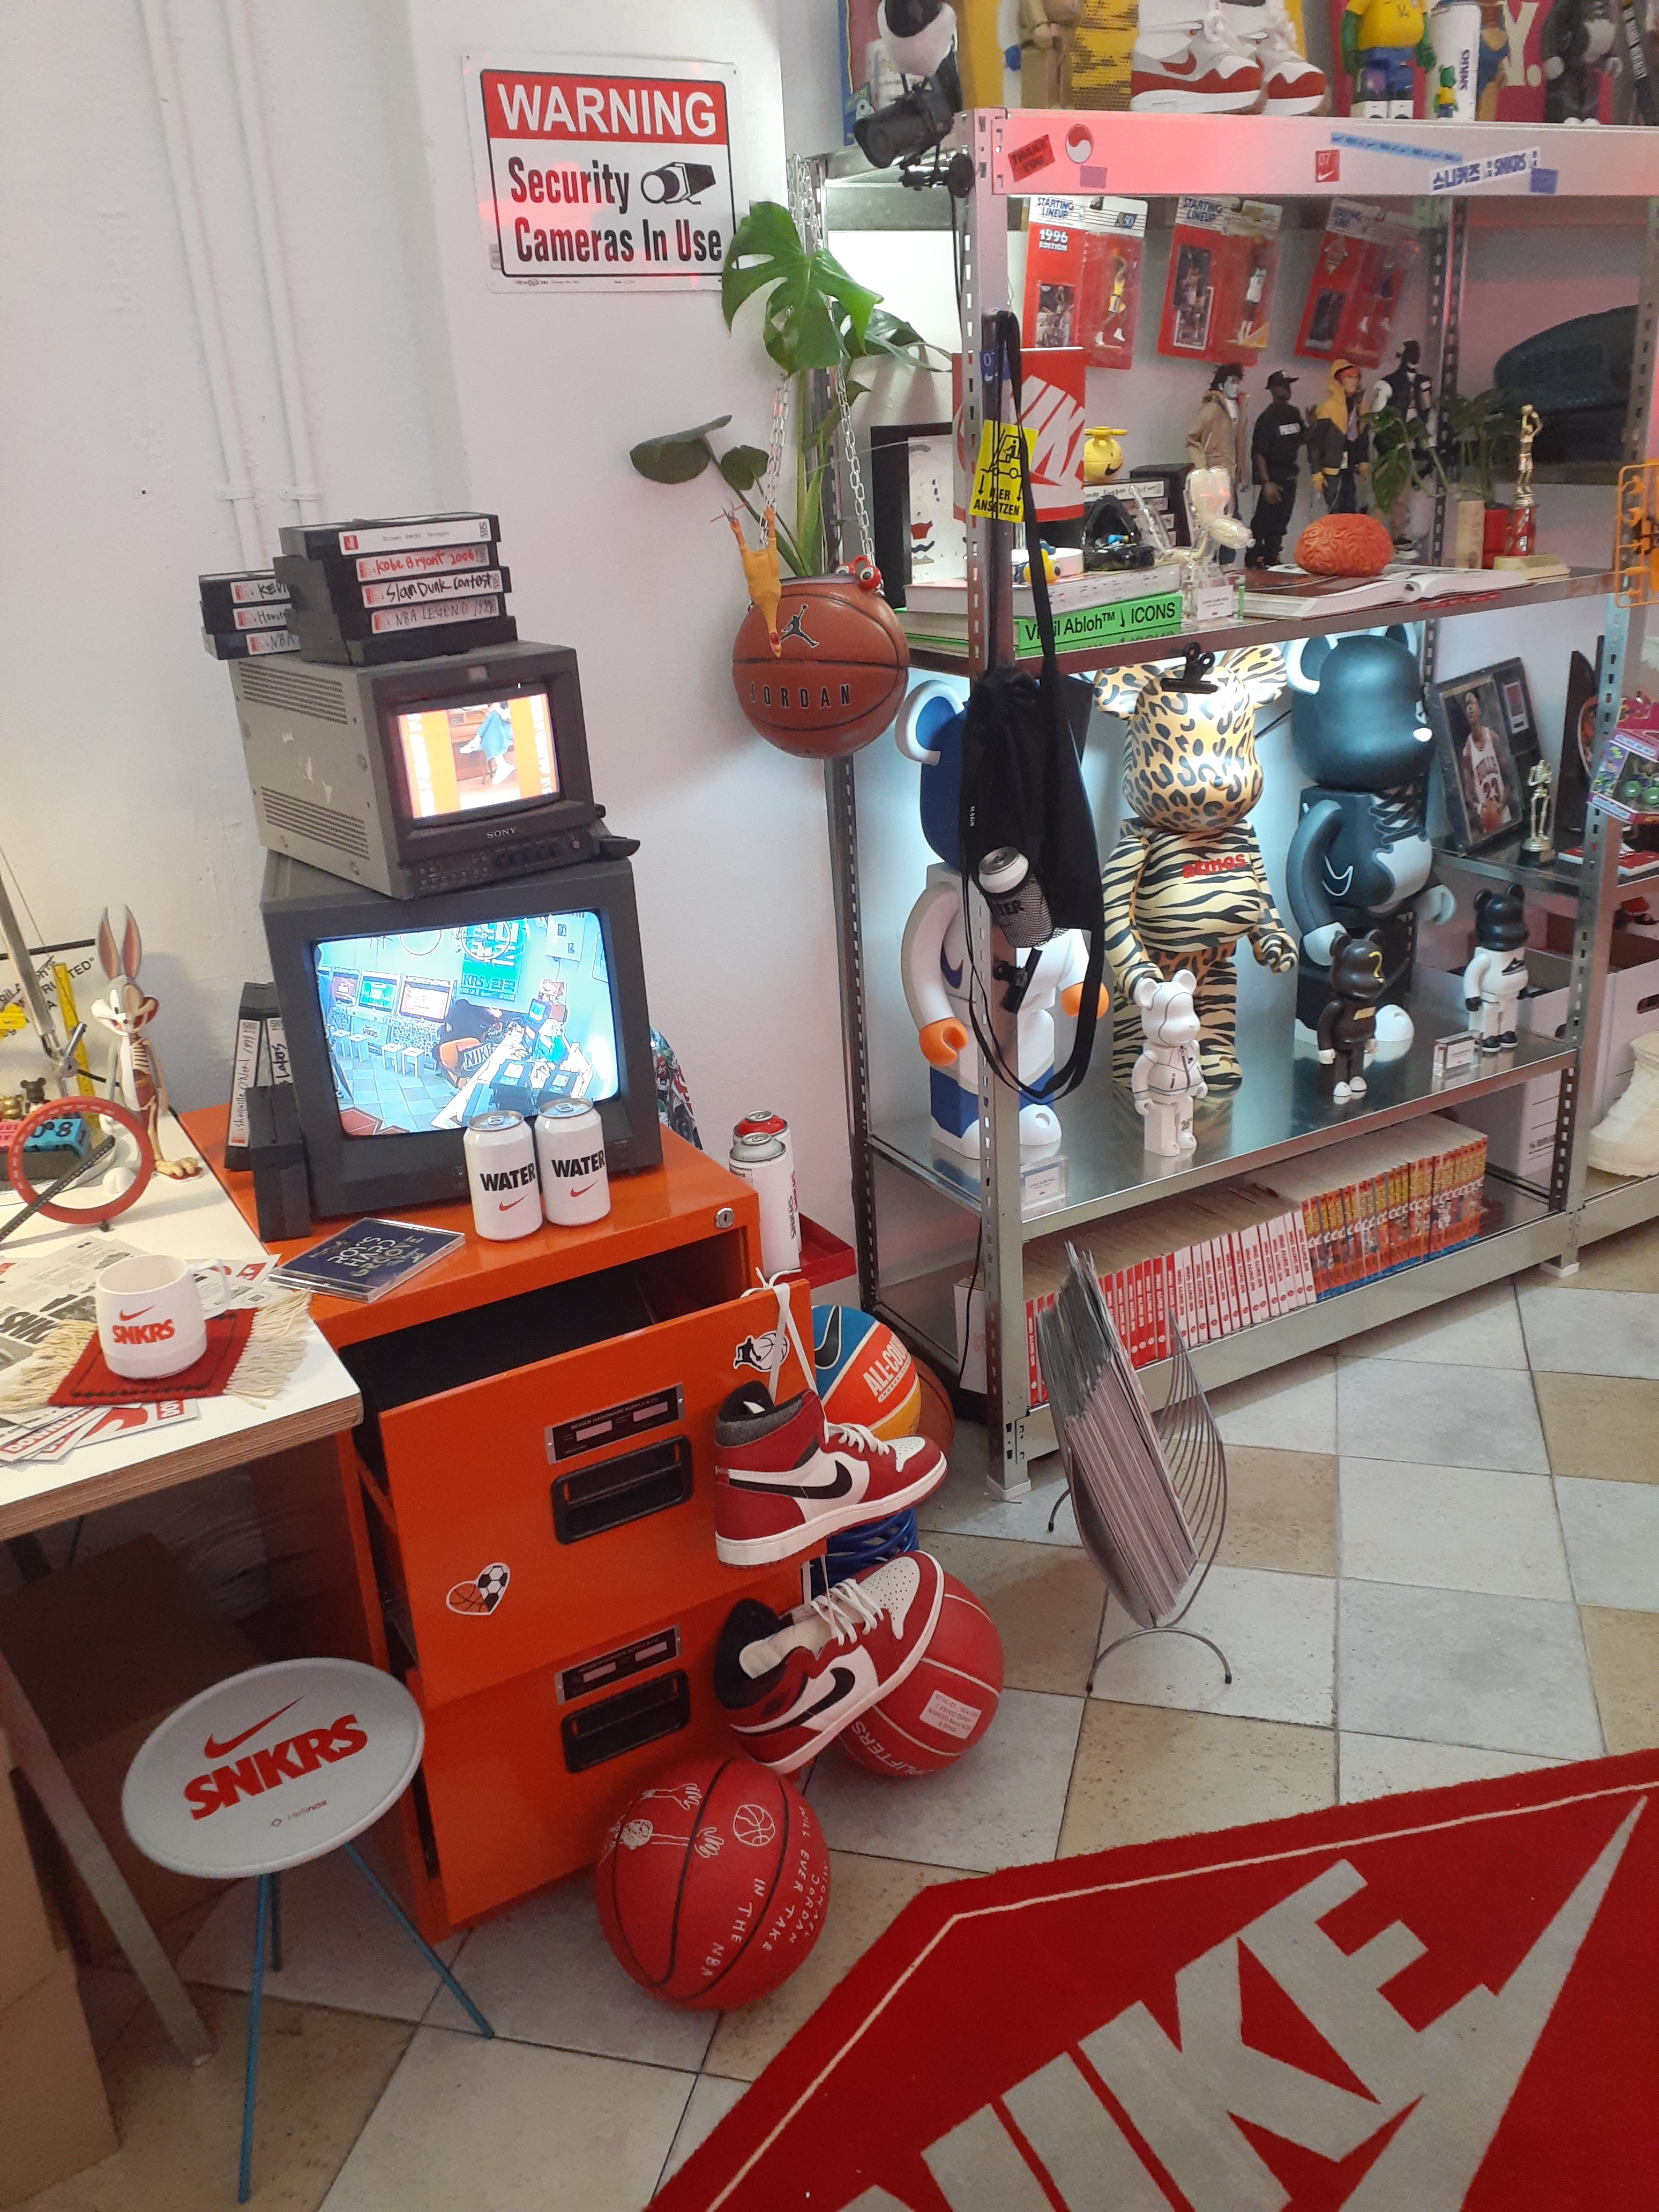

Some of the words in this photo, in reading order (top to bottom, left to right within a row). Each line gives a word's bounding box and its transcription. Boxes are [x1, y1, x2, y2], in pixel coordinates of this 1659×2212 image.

[497, 83, 716, 137] WARNING
[508, 156, 630, 215] Security
[1037, 197, 1074, 211] STARTING
[1041, 207, 1068, 219] LINEUP
[514, 216, 634, 262] Cameras
[642, 219, 668, 261] In
[675, 219, 722, 261] Use
[1039, 227, 1068, 243] 1996
[405, 552, 445, 570] Bryant
[422, 601, 468, 620] LEGEND
[1025, 620, 1060, 641] Viil
[1131, 602, 1176, 624] ICONS
[750, 682, 850, 709] JORDAN
[486, 826, 517, 840] SONY
[1182, 854, 1246, 878] atmos
[480, 1162, 535, 1192] WATER
[551, 1149, 606, 1178] WATER
[111, 1318, 175, 1346] SNKRS
[863, 1333, 908, 1398] ALL-COU
[183, 1713, 368, 1821] SNKRS
[798, 1806, 811, 1837] WILL
[793, 1849, 811, 1892] EVER
[753, 1878, 766, 1897] IN
[730, 1901, 753, 1943] THE
[789, 1874, 820, 1945] JORDAN
[762, 1907, 796, 1952] TAKE
[701, 1942, 726, 1977] NBA
